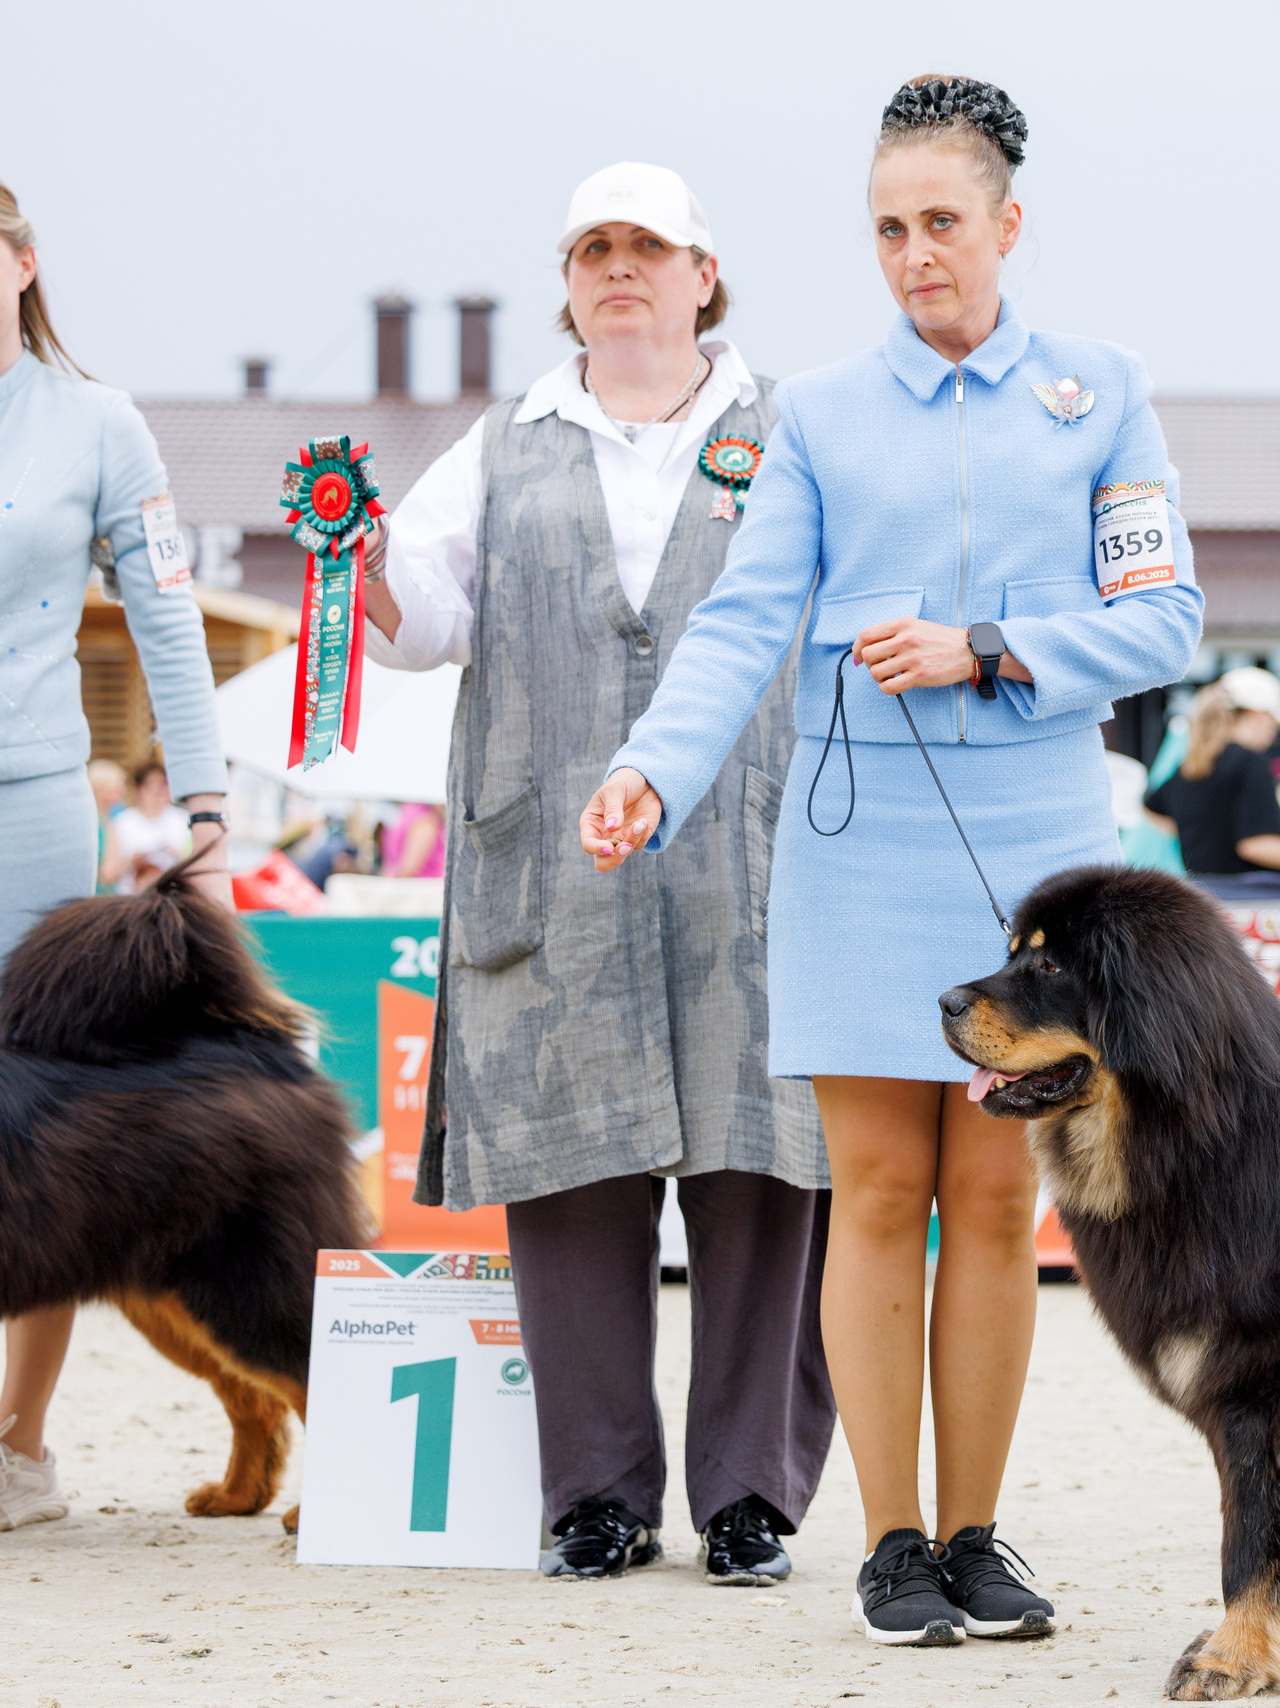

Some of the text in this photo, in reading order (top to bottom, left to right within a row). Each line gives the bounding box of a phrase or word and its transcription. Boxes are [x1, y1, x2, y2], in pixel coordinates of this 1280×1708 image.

[1099, 529, 1163, 563] 1359
[1127, 569, 1170, 584] 8.06.2025
[322, 623, 344, 633] РОССИЯ
[390, 936, 441, 978] 20
[394, 1035, 429, 1081] 7
[328, 1259, 361, 1272] 2025
[329, 1320, 415, 1337] AlphaPet
[481, 1323, 489, 1333] 7
[390, 1356, 457, 1532] 1
